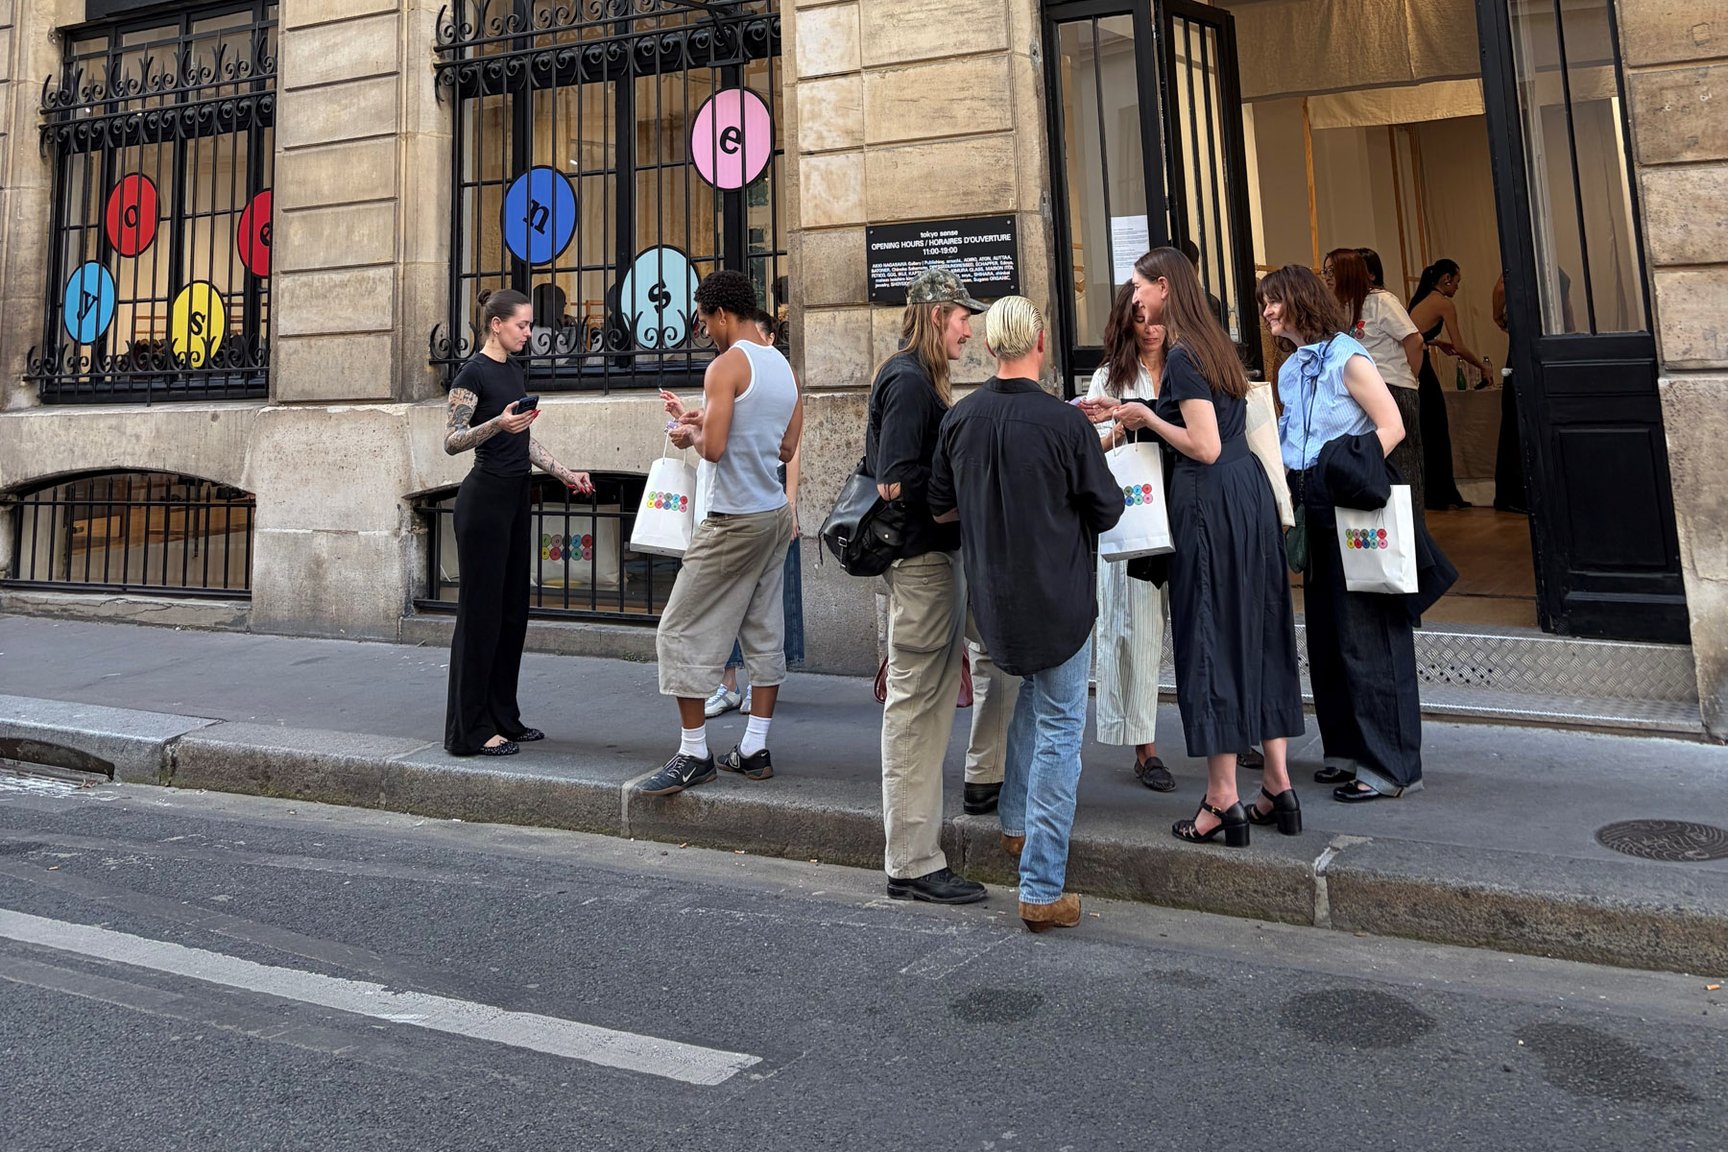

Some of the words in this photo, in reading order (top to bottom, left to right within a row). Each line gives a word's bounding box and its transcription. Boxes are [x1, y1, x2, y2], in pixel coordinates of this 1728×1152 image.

[719, 126, 743, 155] e
[124, 204, 139, 228] o
[522, 199, 550, 235] n
[871, 241, 900, 250] OPENING
[901, 240, 925, 248] HOURS
[929, 237, 963, 247] HORAIRES
[964, 233, 1012, 244] D'OUVERTURE
[920, 230, 938, 238] tokyo
[940, 229, 959, 237] sense
[922, 246, 958, 255] 11:00-19:00
[77, 291, 99, 321] y
[648, 279, 672, 314] s
[190, 311, 206, 336] s
